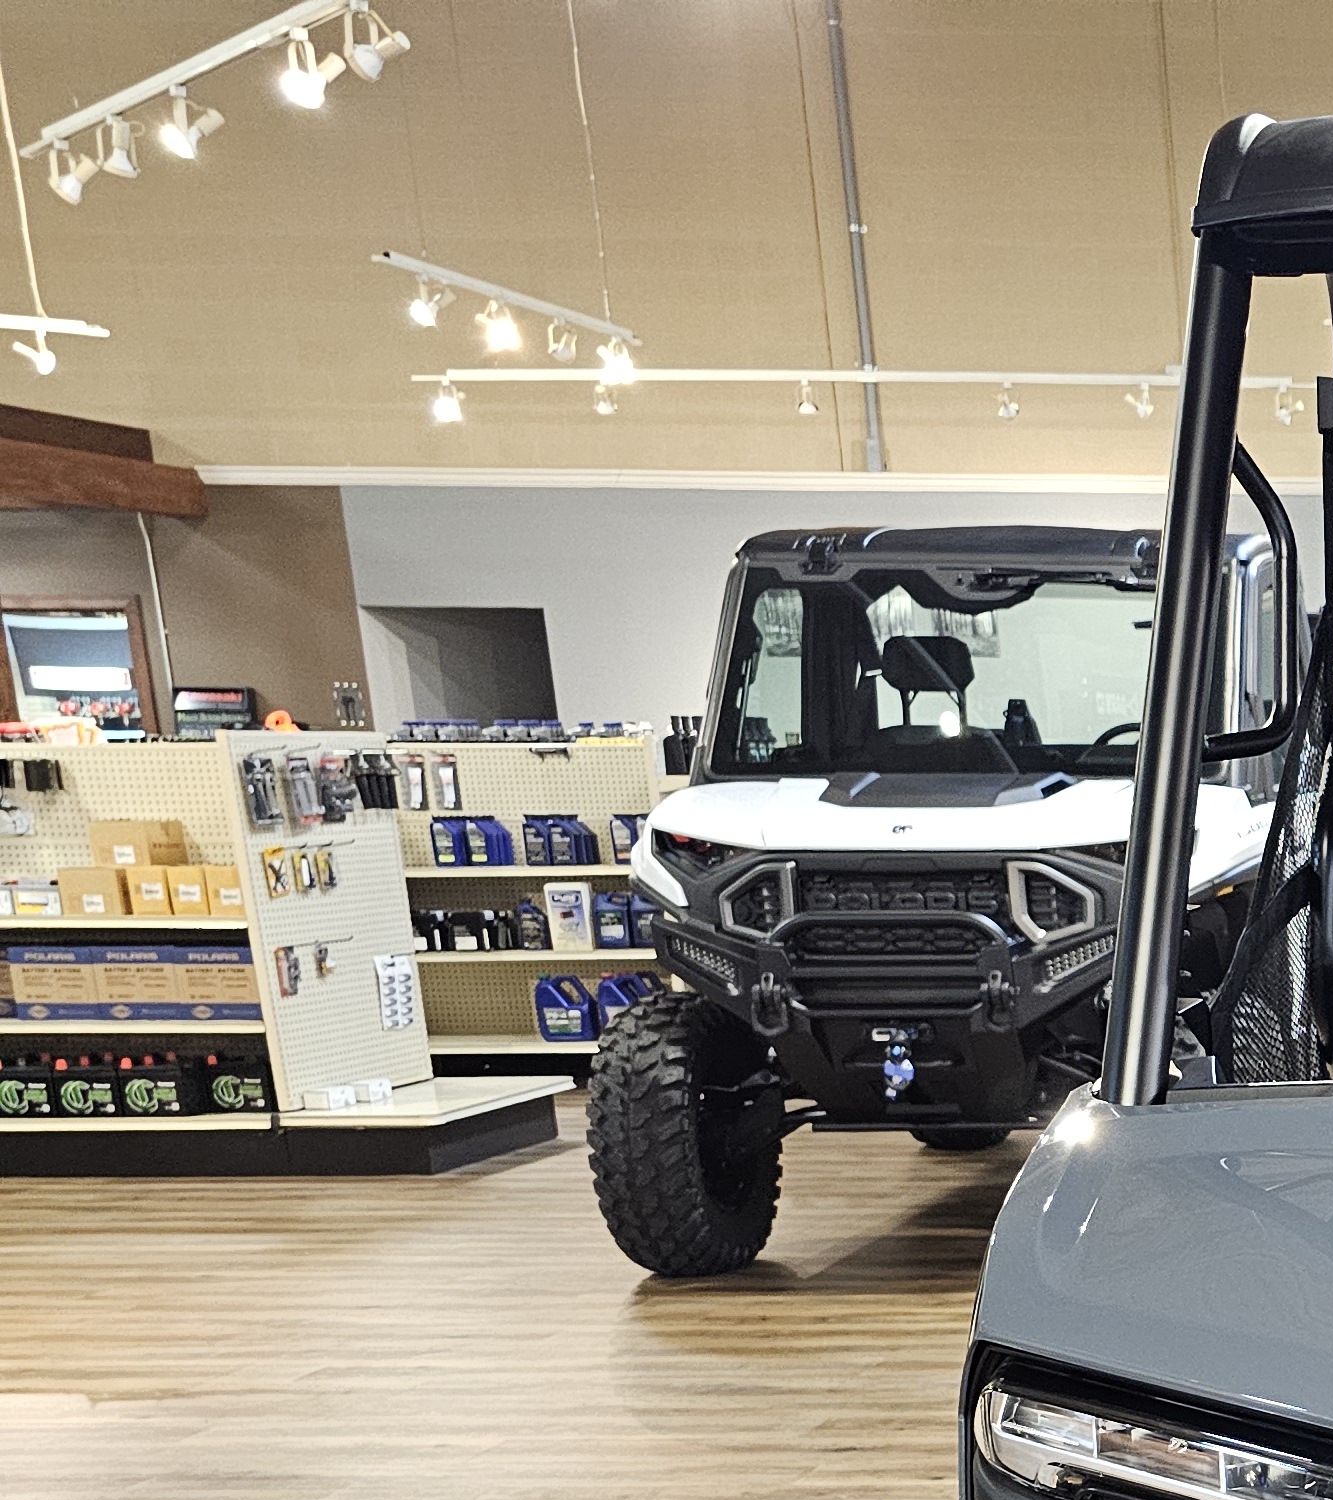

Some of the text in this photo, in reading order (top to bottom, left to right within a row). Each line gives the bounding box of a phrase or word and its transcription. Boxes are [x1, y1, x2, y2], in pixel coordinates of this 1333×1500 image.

[808, 891, 999, 914] POLARIS
[23, 951, 77, 963] POLARIS
[105, 951, 159, 962] POLARIS
[187, 952, 240, 963] POLARIS
